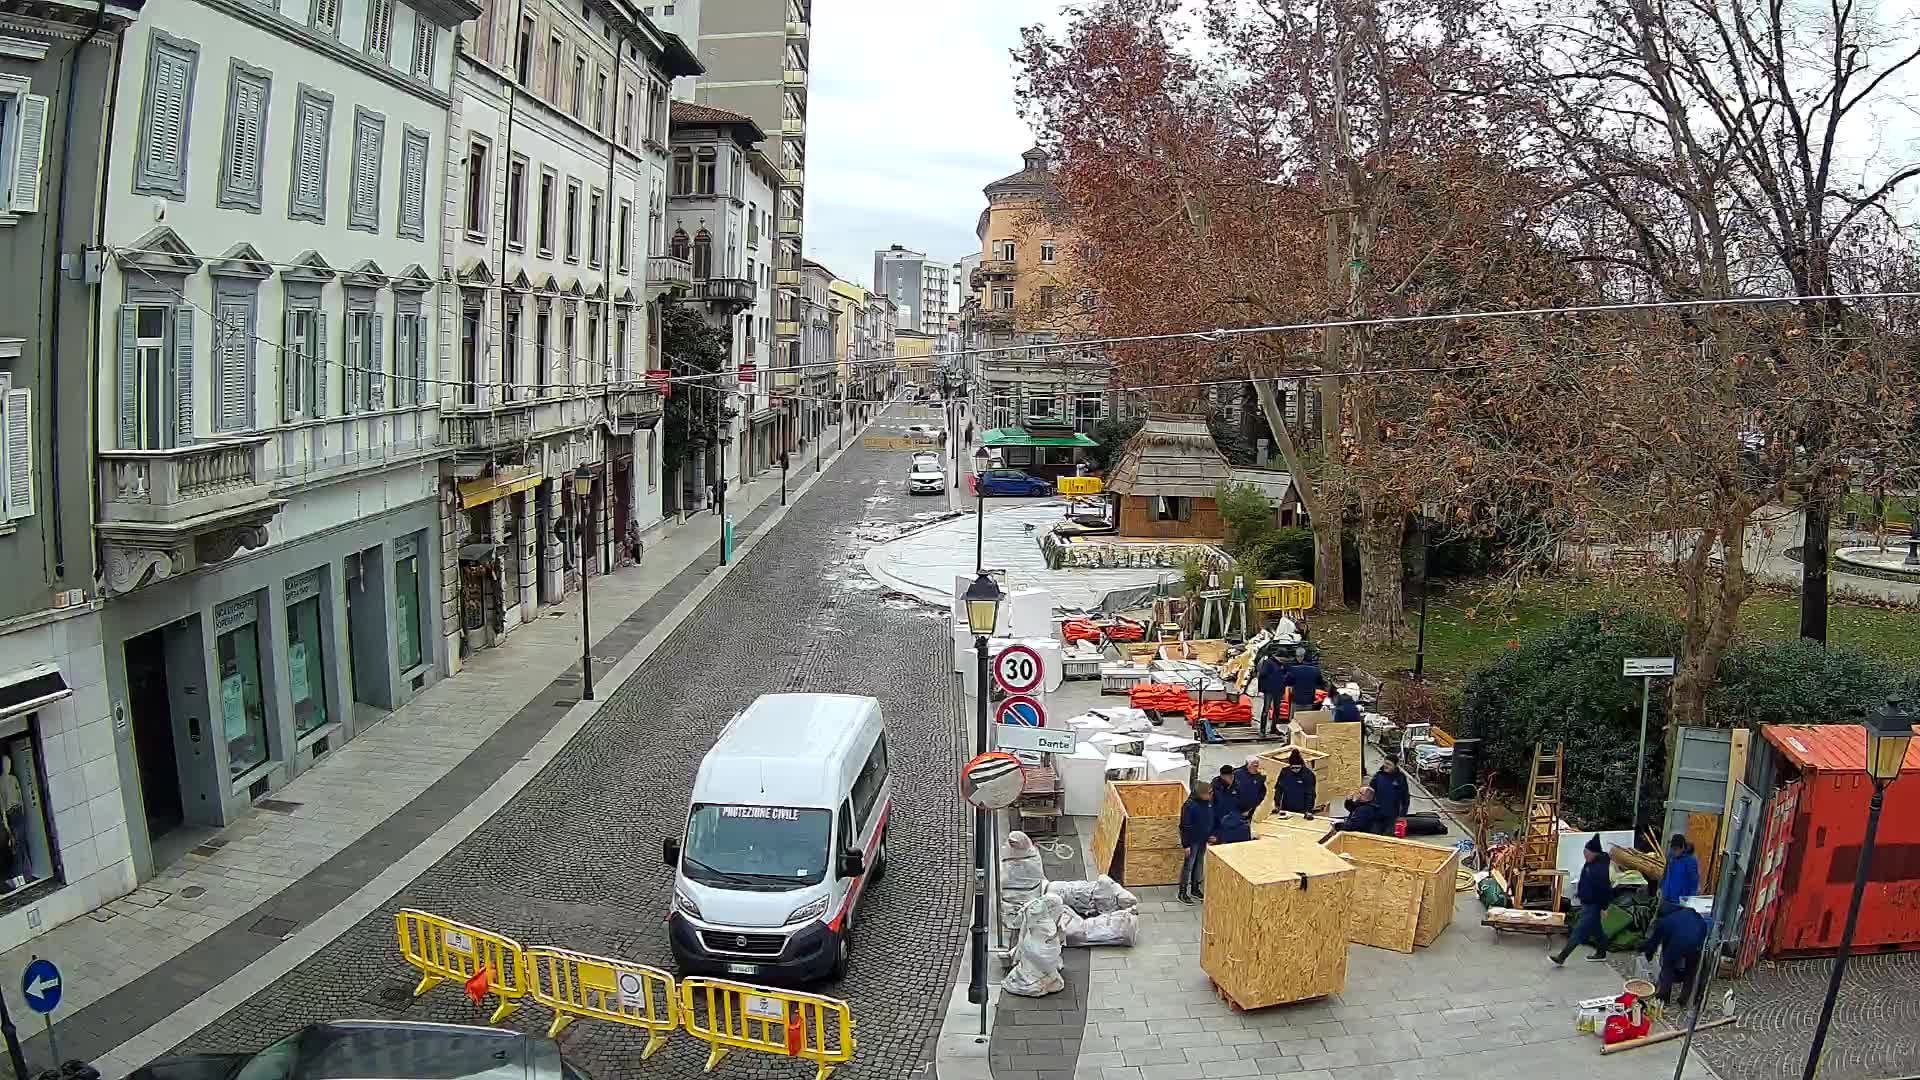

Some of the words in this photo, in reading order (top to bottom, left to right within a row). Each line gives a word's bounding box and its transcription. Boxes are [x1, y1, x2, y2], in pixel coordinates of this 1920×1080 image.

[1005, 658, 1033, 680] 30
[1039, 738, 1070, 749] Dante
[722, 806, 771, 819] PROTEZIONE
[772, 807, 800, 821] CIVILE
